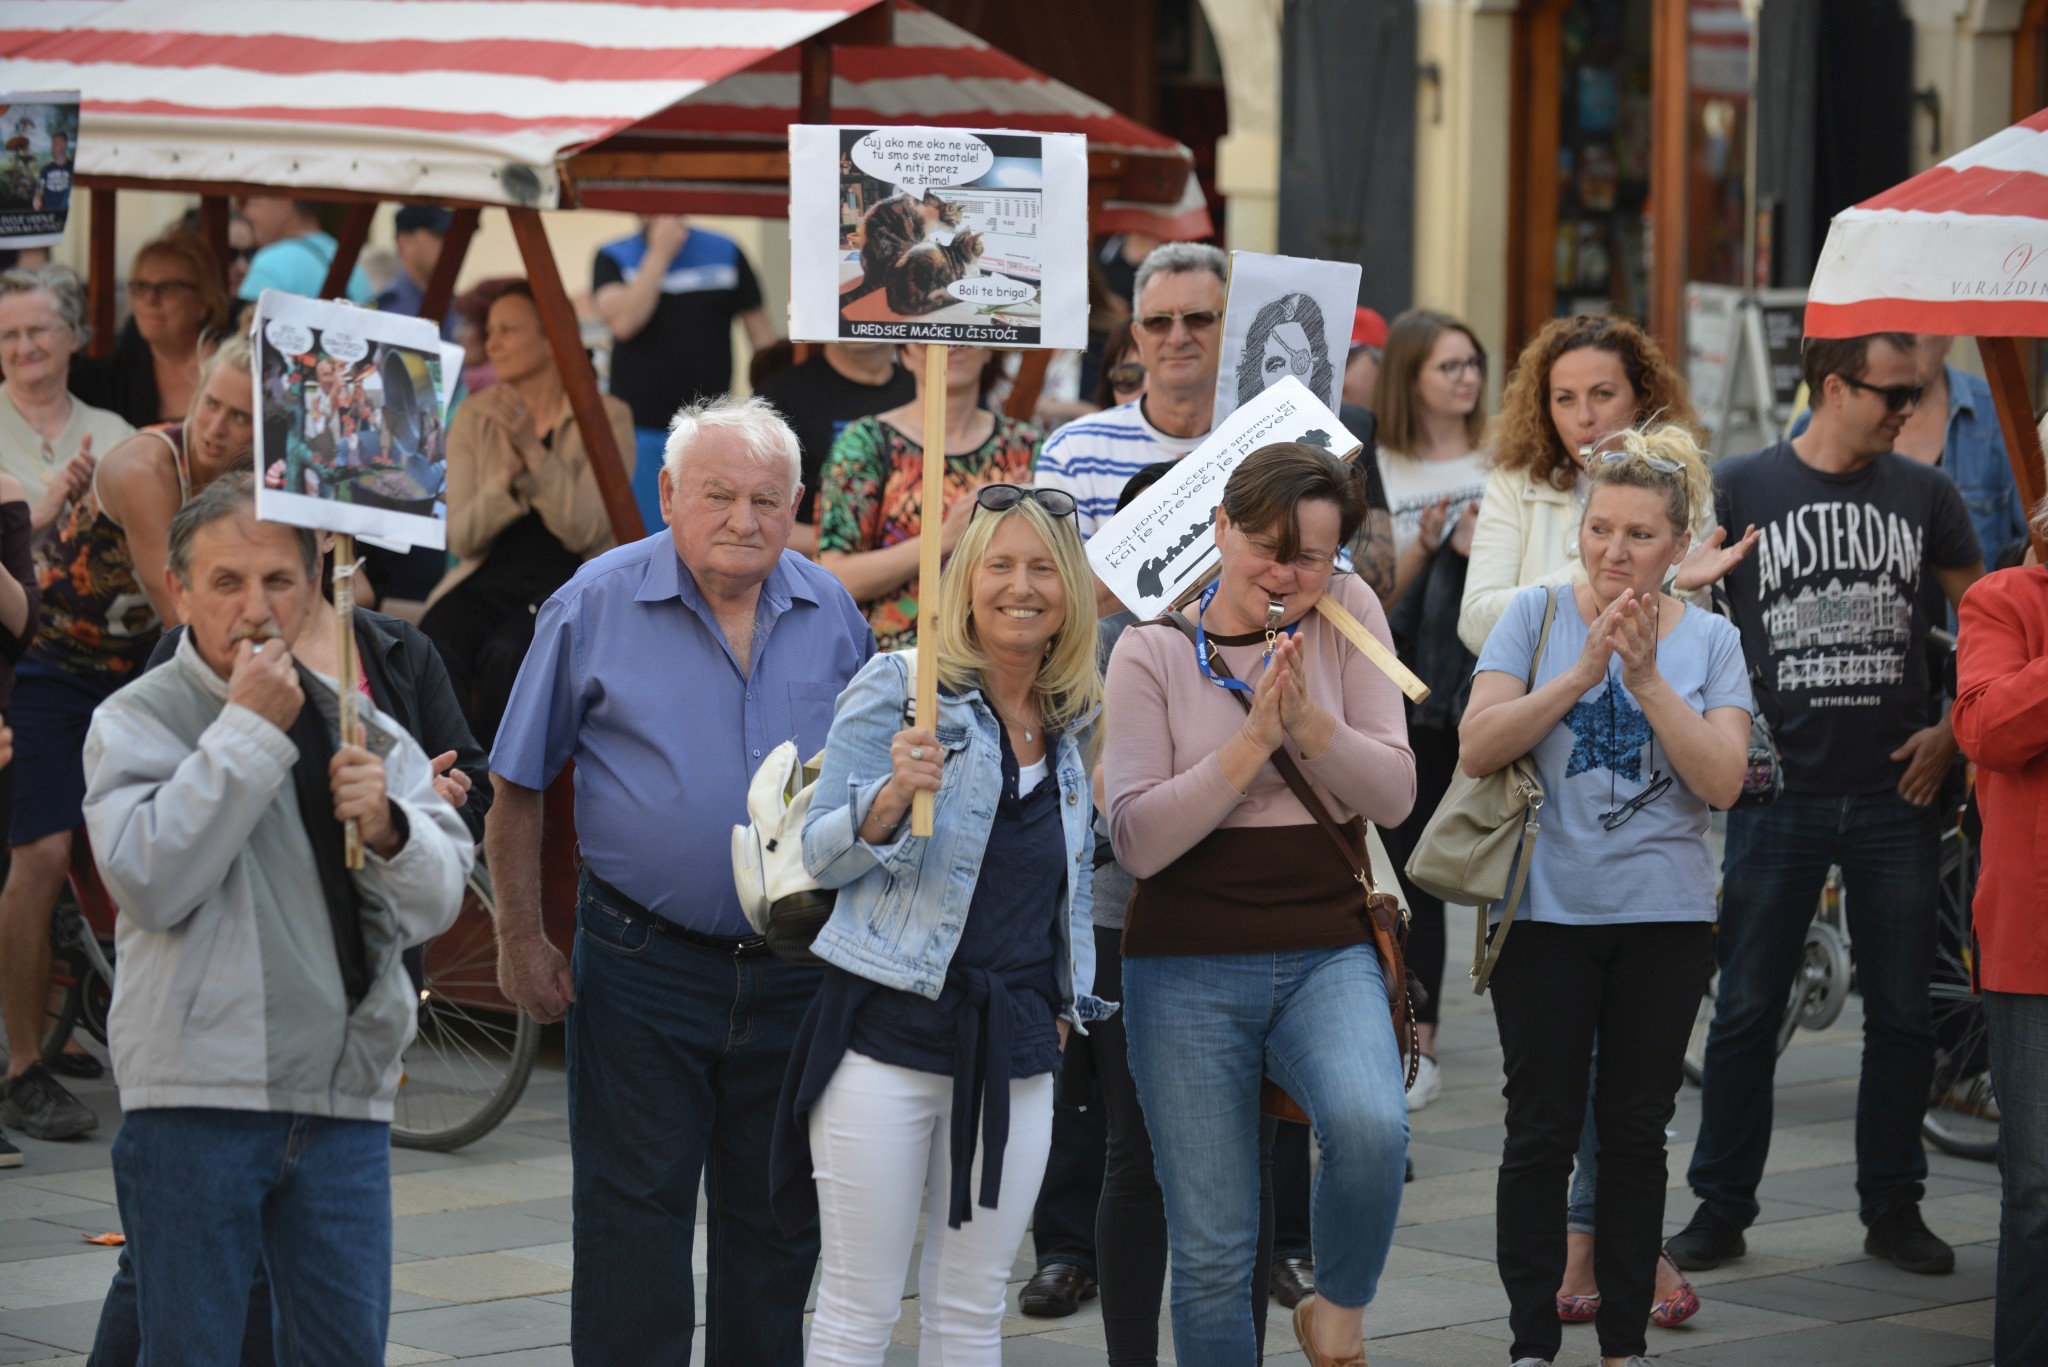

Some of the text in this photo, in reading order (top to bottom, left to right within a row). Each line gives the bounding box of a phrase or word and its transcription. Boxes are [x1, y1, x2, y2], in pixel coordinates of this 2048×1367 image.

[885, 137, 904, 148] ako
[907, 140, 924, 149] me
[927, 139, 945, 149] oko
[948, 142, 961, 150] ne
[964, 142, 987, 151] vara
[872, 151, 979, 163] tu smo sve zmotale!
[894, 162, 958, 176] A niti porez
[902, 175, 950, 185] ne štima!
[959, 285, 1027, 301] Boli te briga!
[851, 324, 1018, 340] UREDSKE MAČKE U ČISTOĆI
[1105, 400, 1290, 561] POSLJEDNJA VEČERA se sprema, jer
[1110, 404, 1298, 569] kaj je preveč, je preveč!
[1810, 696, 1882, 708] NETHERLANDS
